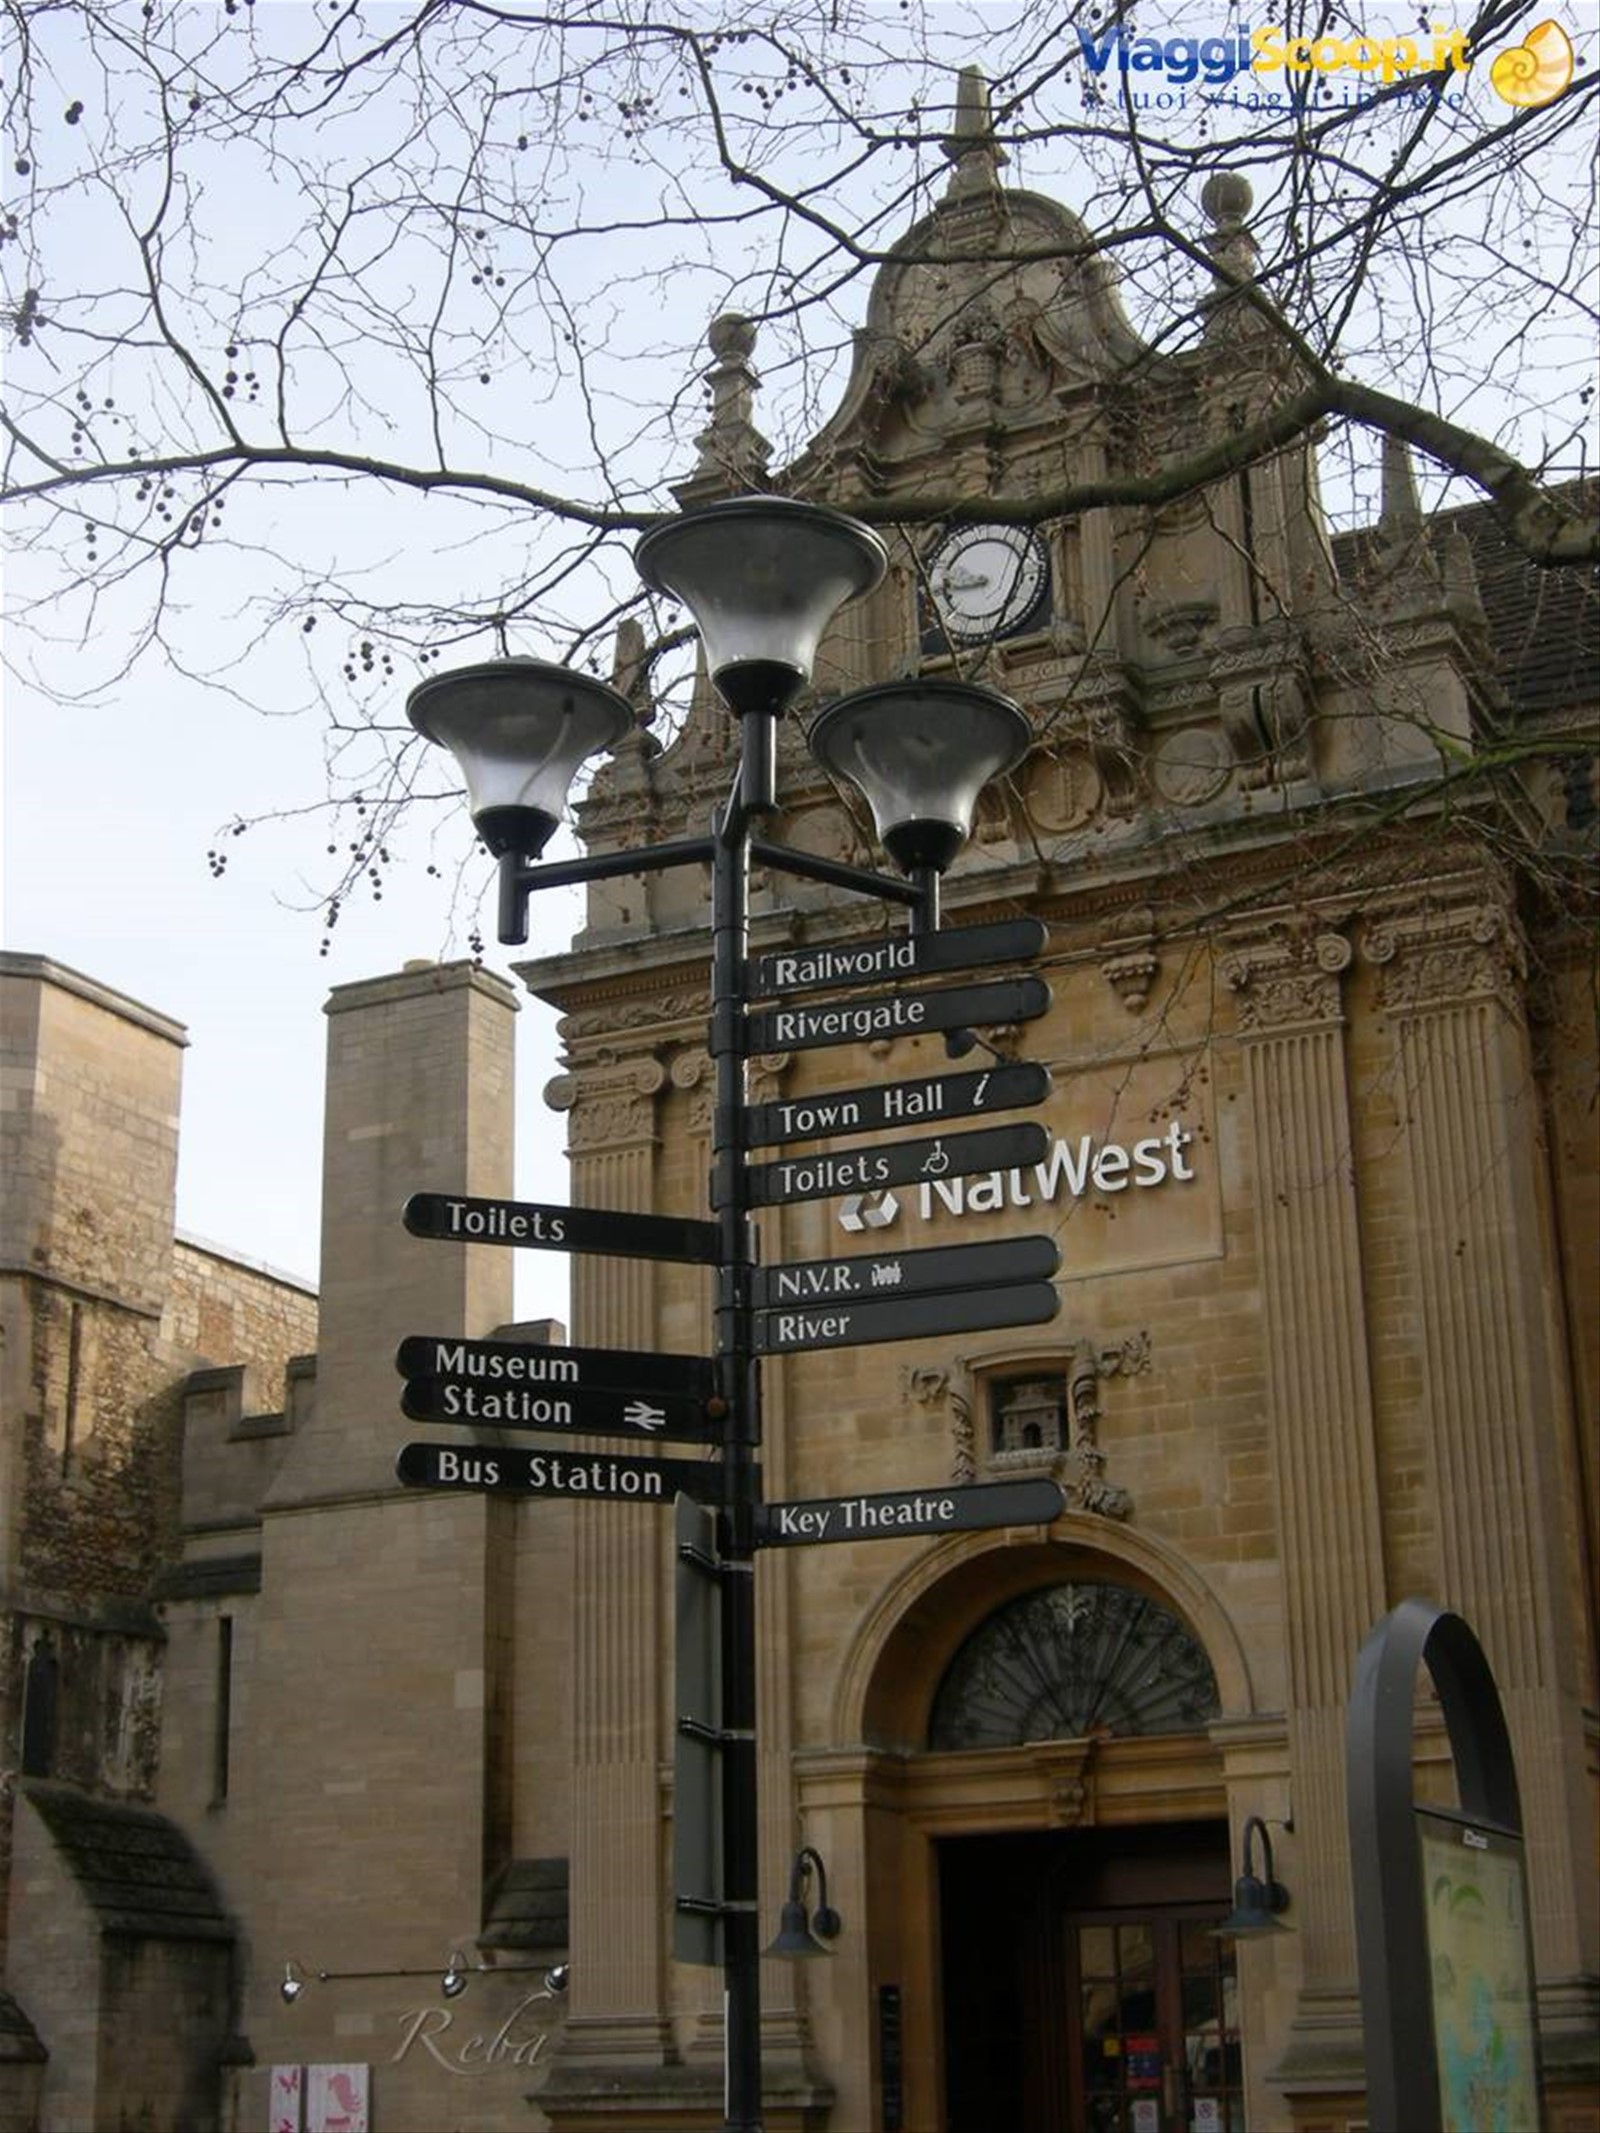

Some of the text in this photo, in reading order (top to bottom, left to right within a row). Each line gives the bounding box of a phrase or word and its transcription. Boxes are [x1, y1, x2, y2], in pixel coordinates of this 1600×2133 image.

[776, 941, 916, 985] Railworld
[776, 1000, 925, 1042] Rivergate
[779, 1103, 860, 1134] Town
[884, 1084, 943, 1118] Hall
[779, 1158, 889, 1193] Toilets
[446, 1202, 566, 1242] Toilets
[778, 1265, 861, 1297] N.V.R.
[778, 1314, 850, 1342] River
[436, 1344, 579, 1382] Museum
[443, 1384, 572, 1424] Station
[438, 1451, 662, 1495] Bus Station
[780, 1497, 955, 1538] Key Theatre
